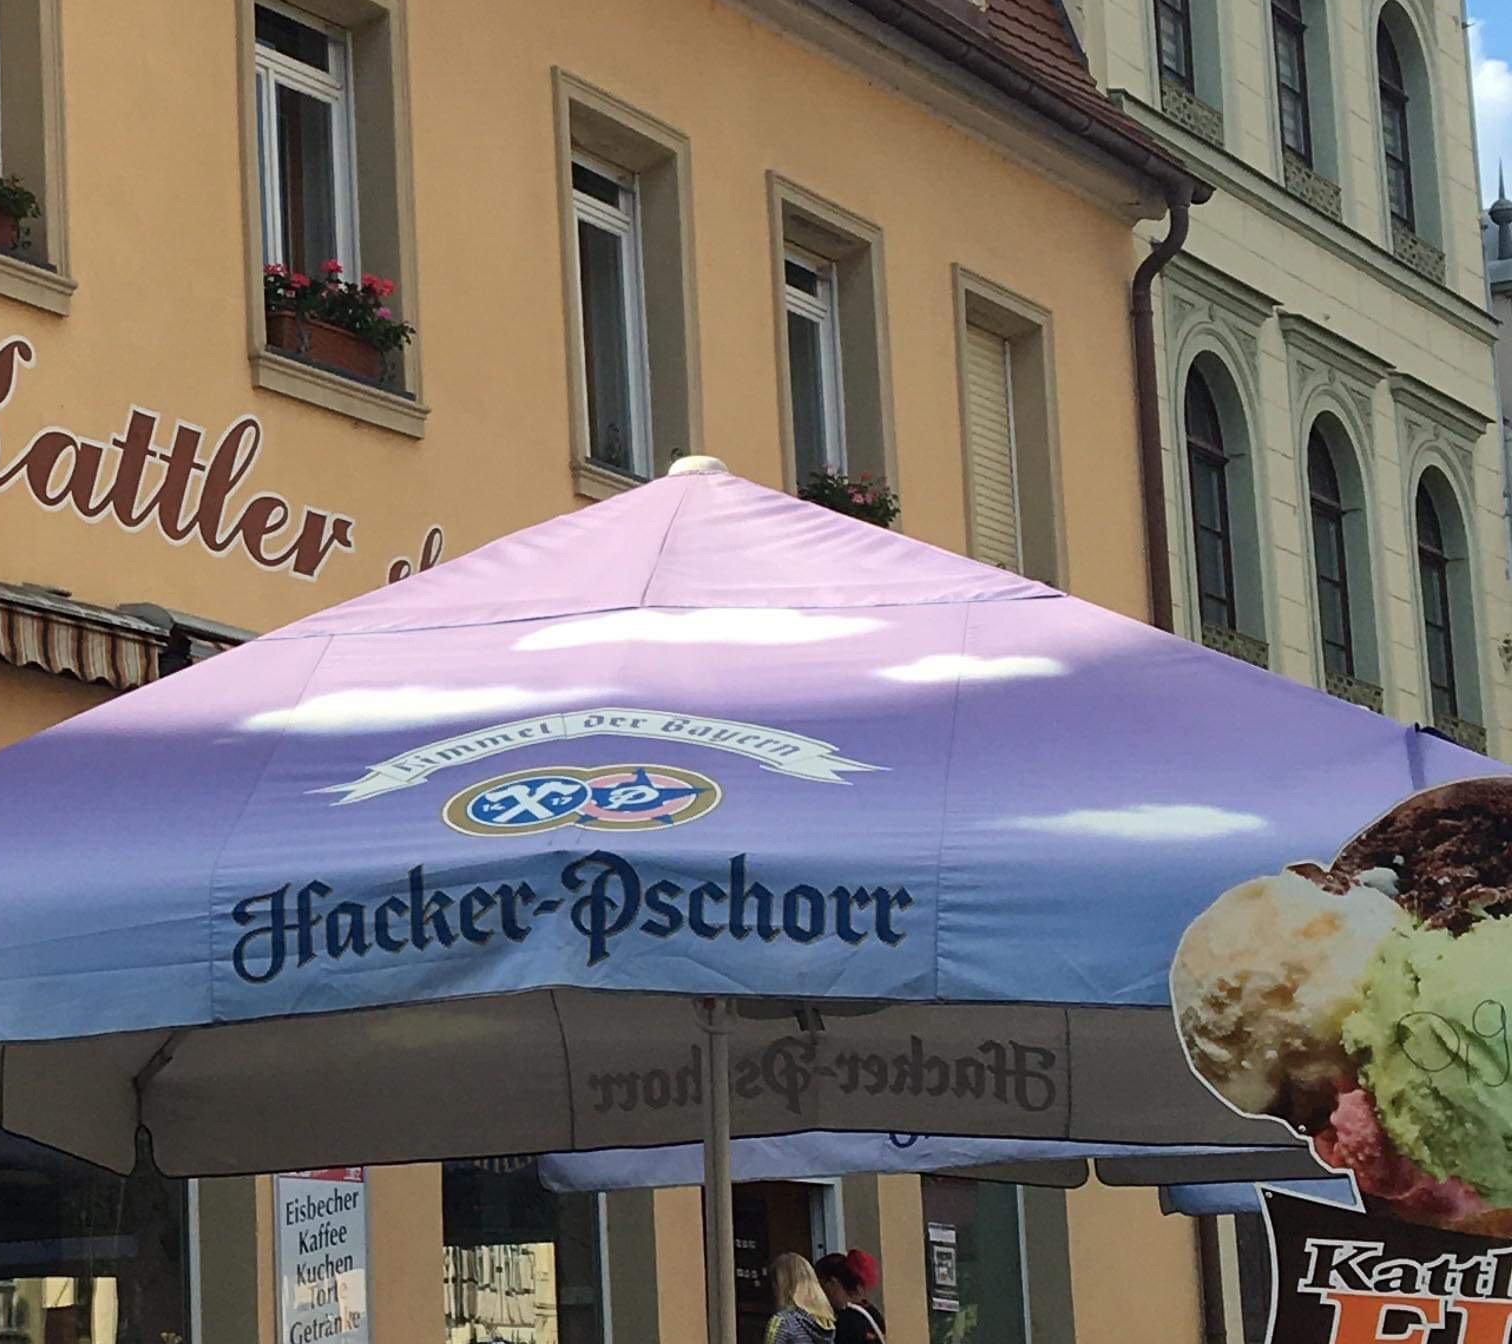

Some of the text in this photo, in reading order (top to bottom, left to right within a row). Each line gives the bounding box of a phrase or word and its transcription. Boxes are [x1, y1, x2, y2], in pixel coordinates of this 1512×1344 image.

[584, 714, 647, 730] der
[661, 718, 800, 757] Bayern
[232, 849, 915, 984] Hacker-Pschorr
[285, 1188, 359, 1226] Eisbecher
[298, 1221, 348, 1255] Kaffee
[296, 1253, 354, 1288] Kuchen
